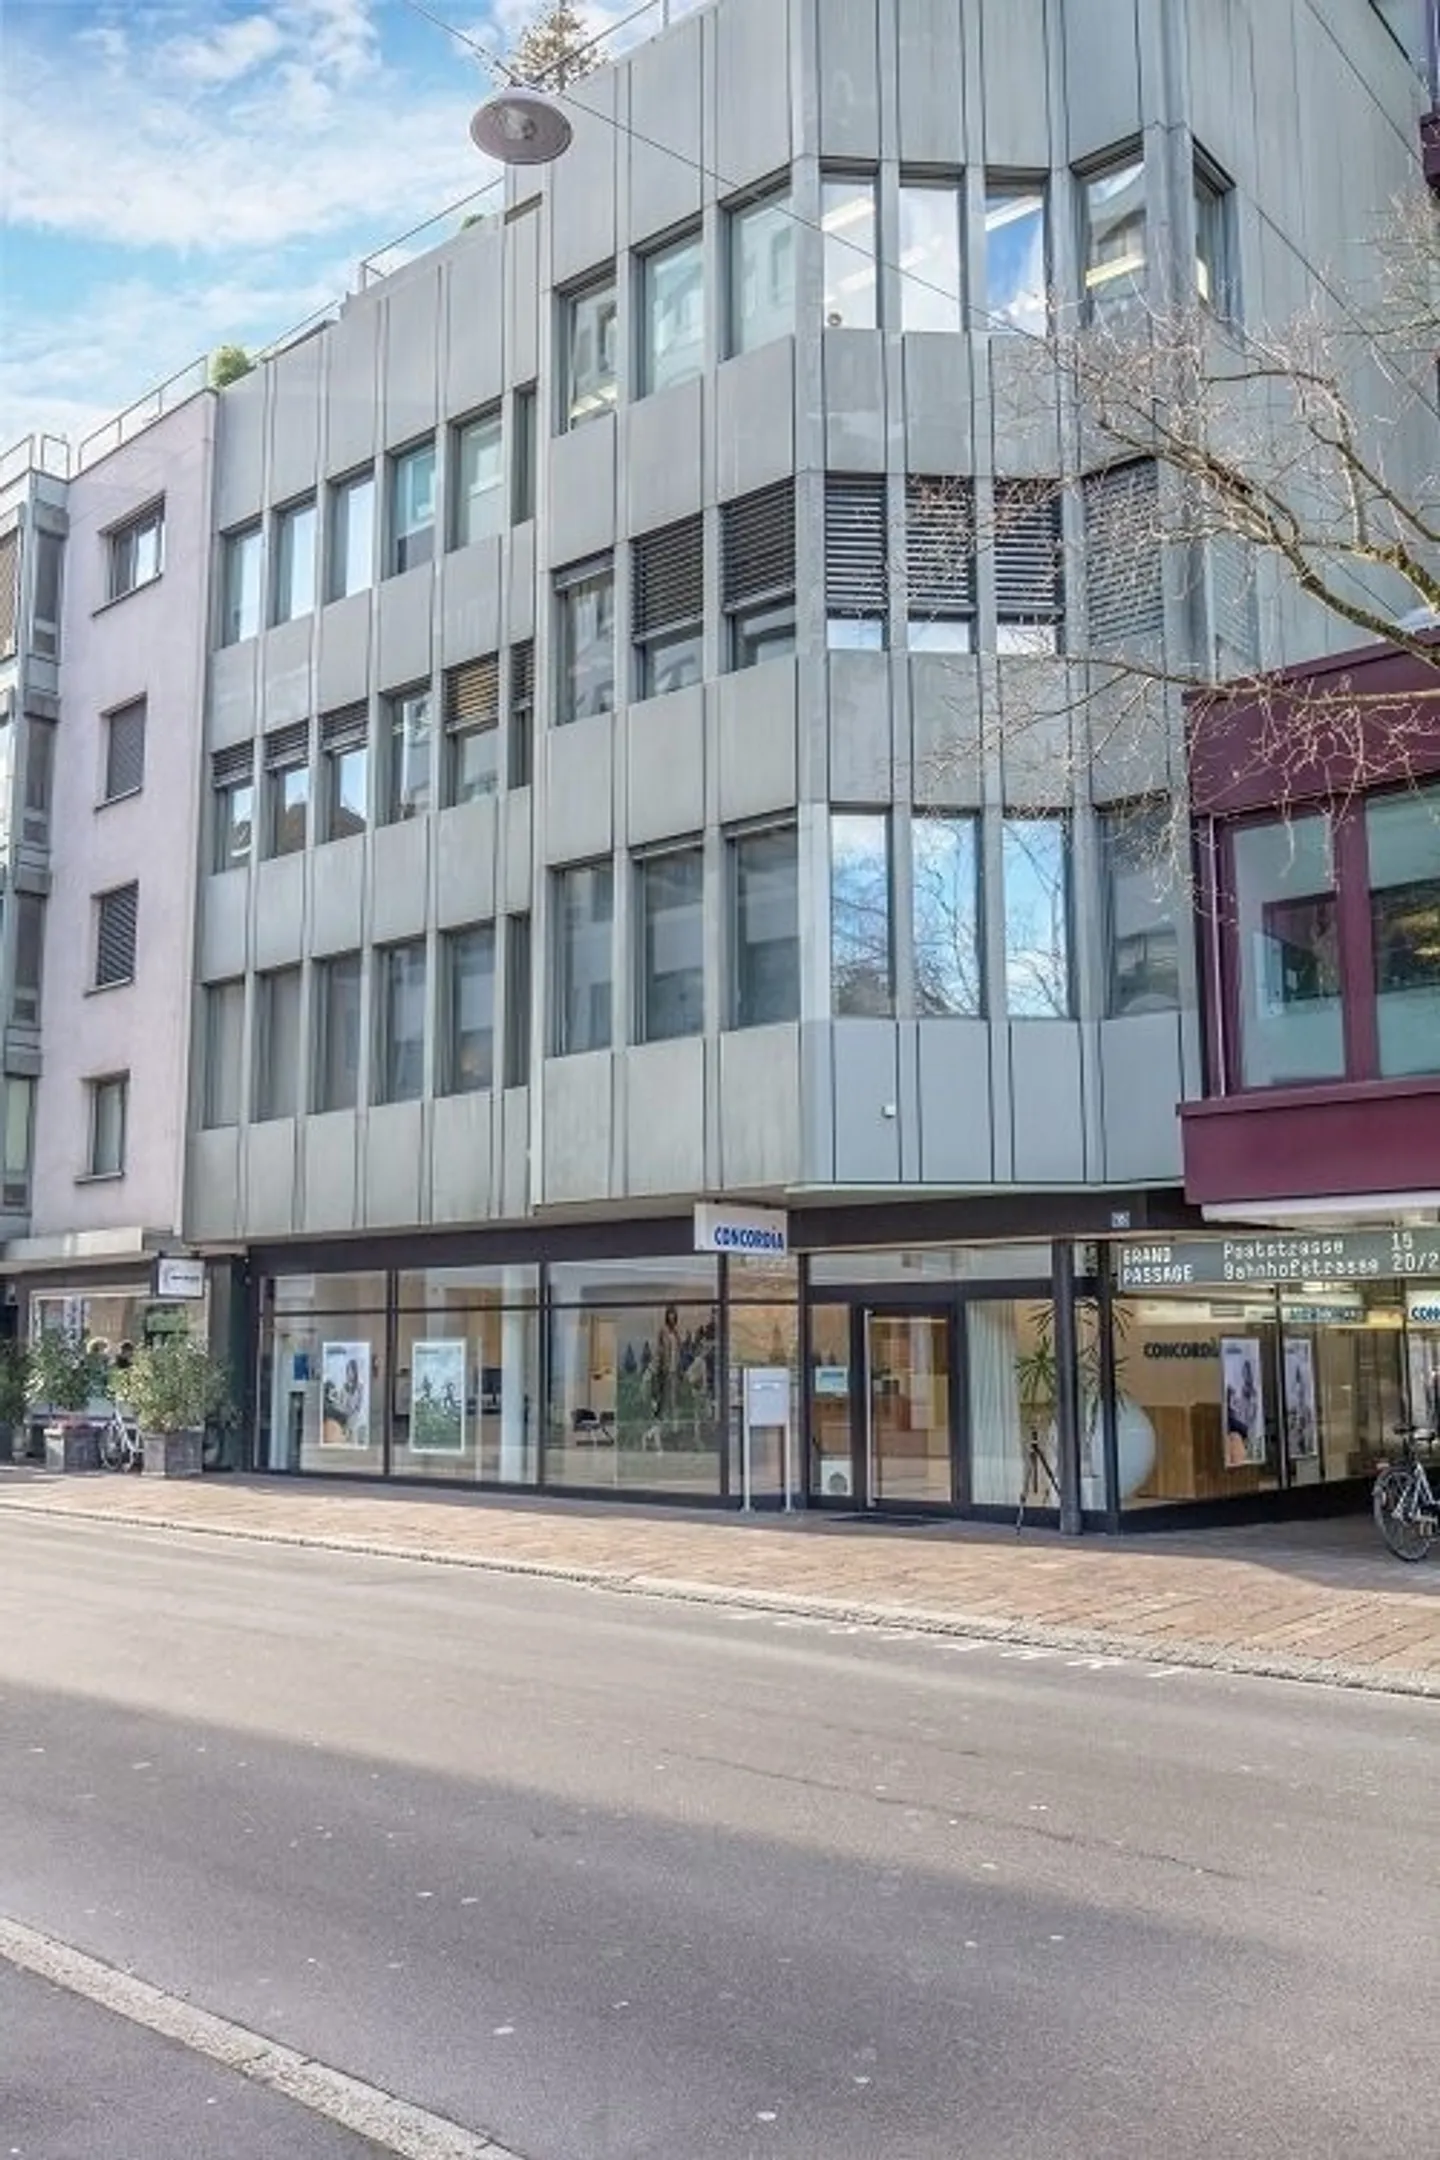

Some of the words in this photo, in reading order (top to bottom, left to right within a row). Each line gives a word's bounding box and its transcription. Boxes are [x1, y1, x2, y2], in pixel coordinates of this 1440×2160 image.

[1122, 1246, 1171, 1265] GRAND
[1122, 1264, 1193, 1285] PASSAGE
[1223, 1259, 1379, 1280] Bahnhofstrasse
